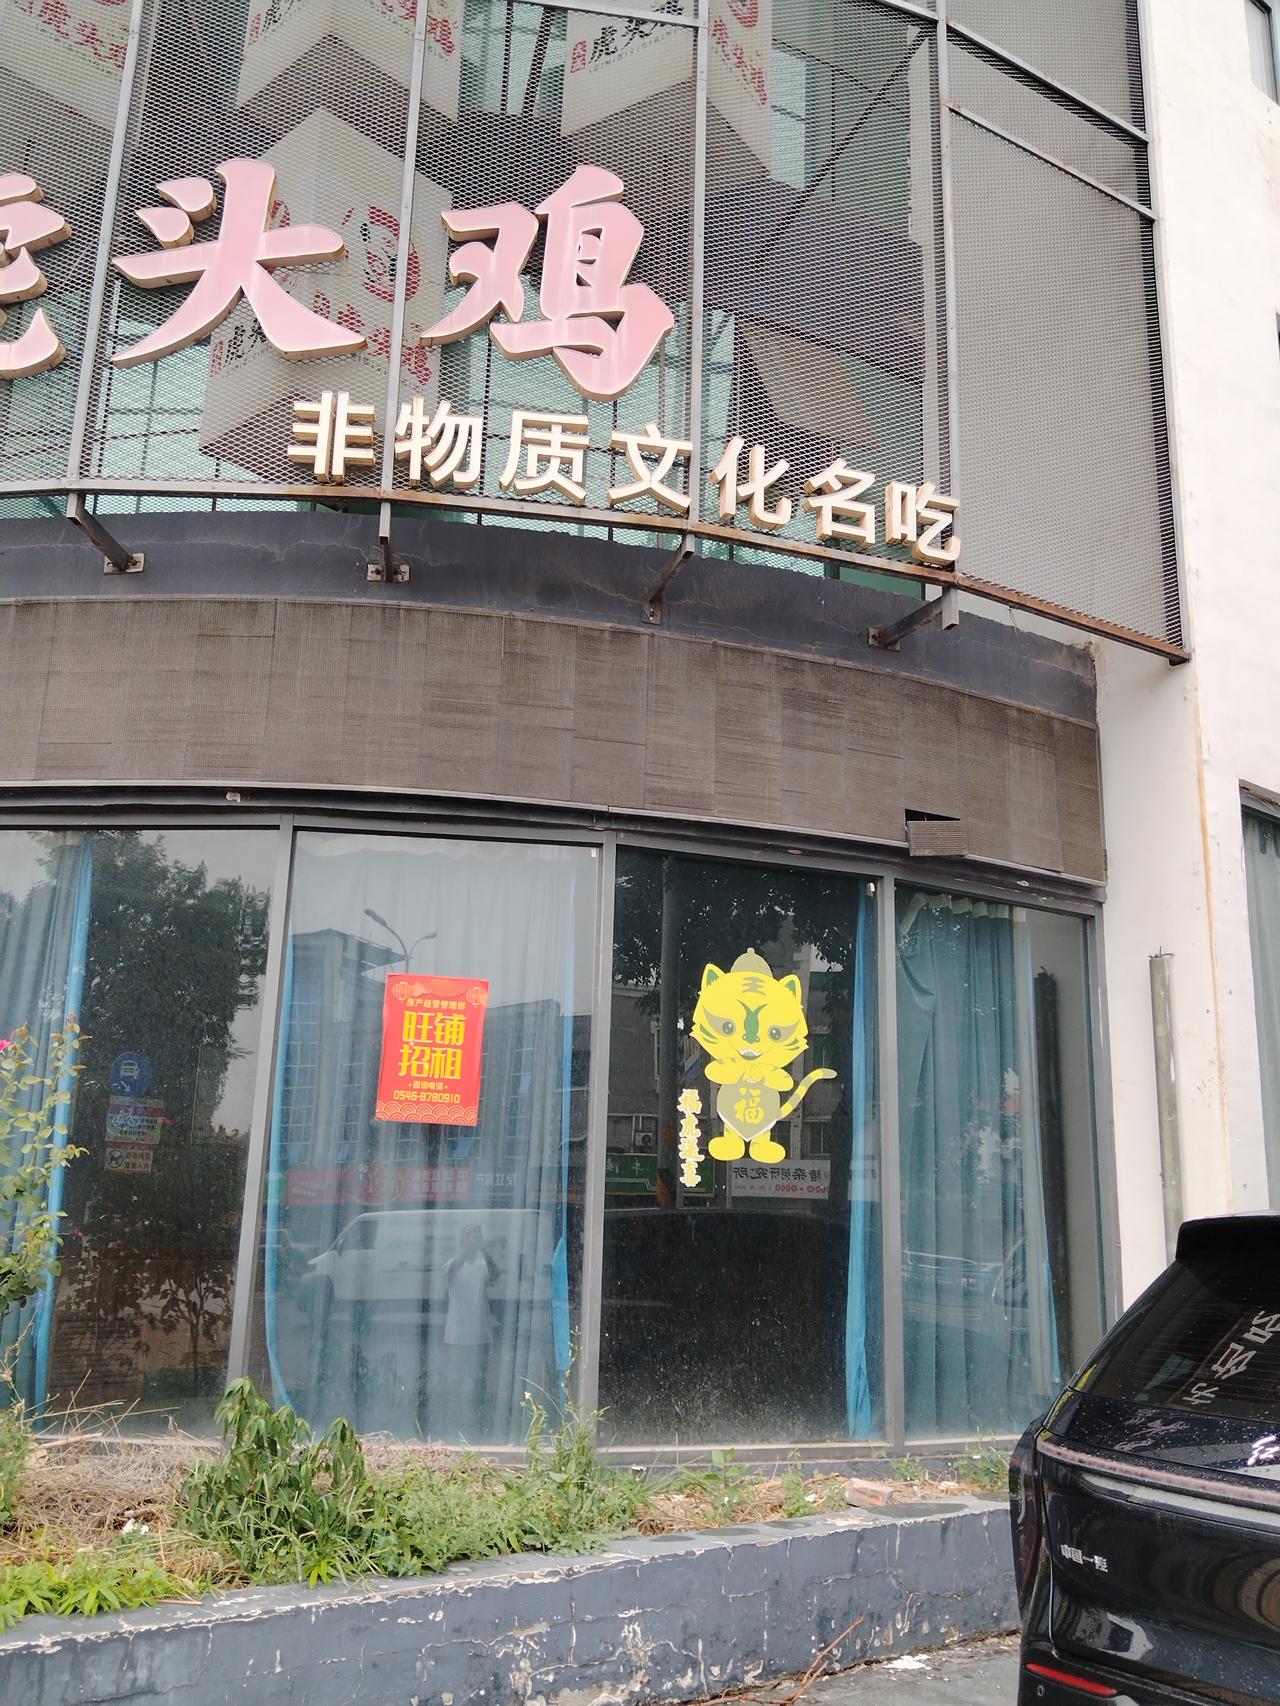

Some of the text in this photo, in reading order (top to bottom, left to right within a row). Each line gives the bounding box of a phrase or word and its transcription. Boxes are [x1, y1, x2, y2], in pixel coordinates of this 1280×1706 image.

[287, 390, 963, 567] 非物质文化名吃
[403, 1011, 466, 1045] 旺铺
[399, 1045, 462, 1080] 招租
[393, 1091, 461, 1104] 0546-8780910
[734, 1087, 765, 1125] 福
